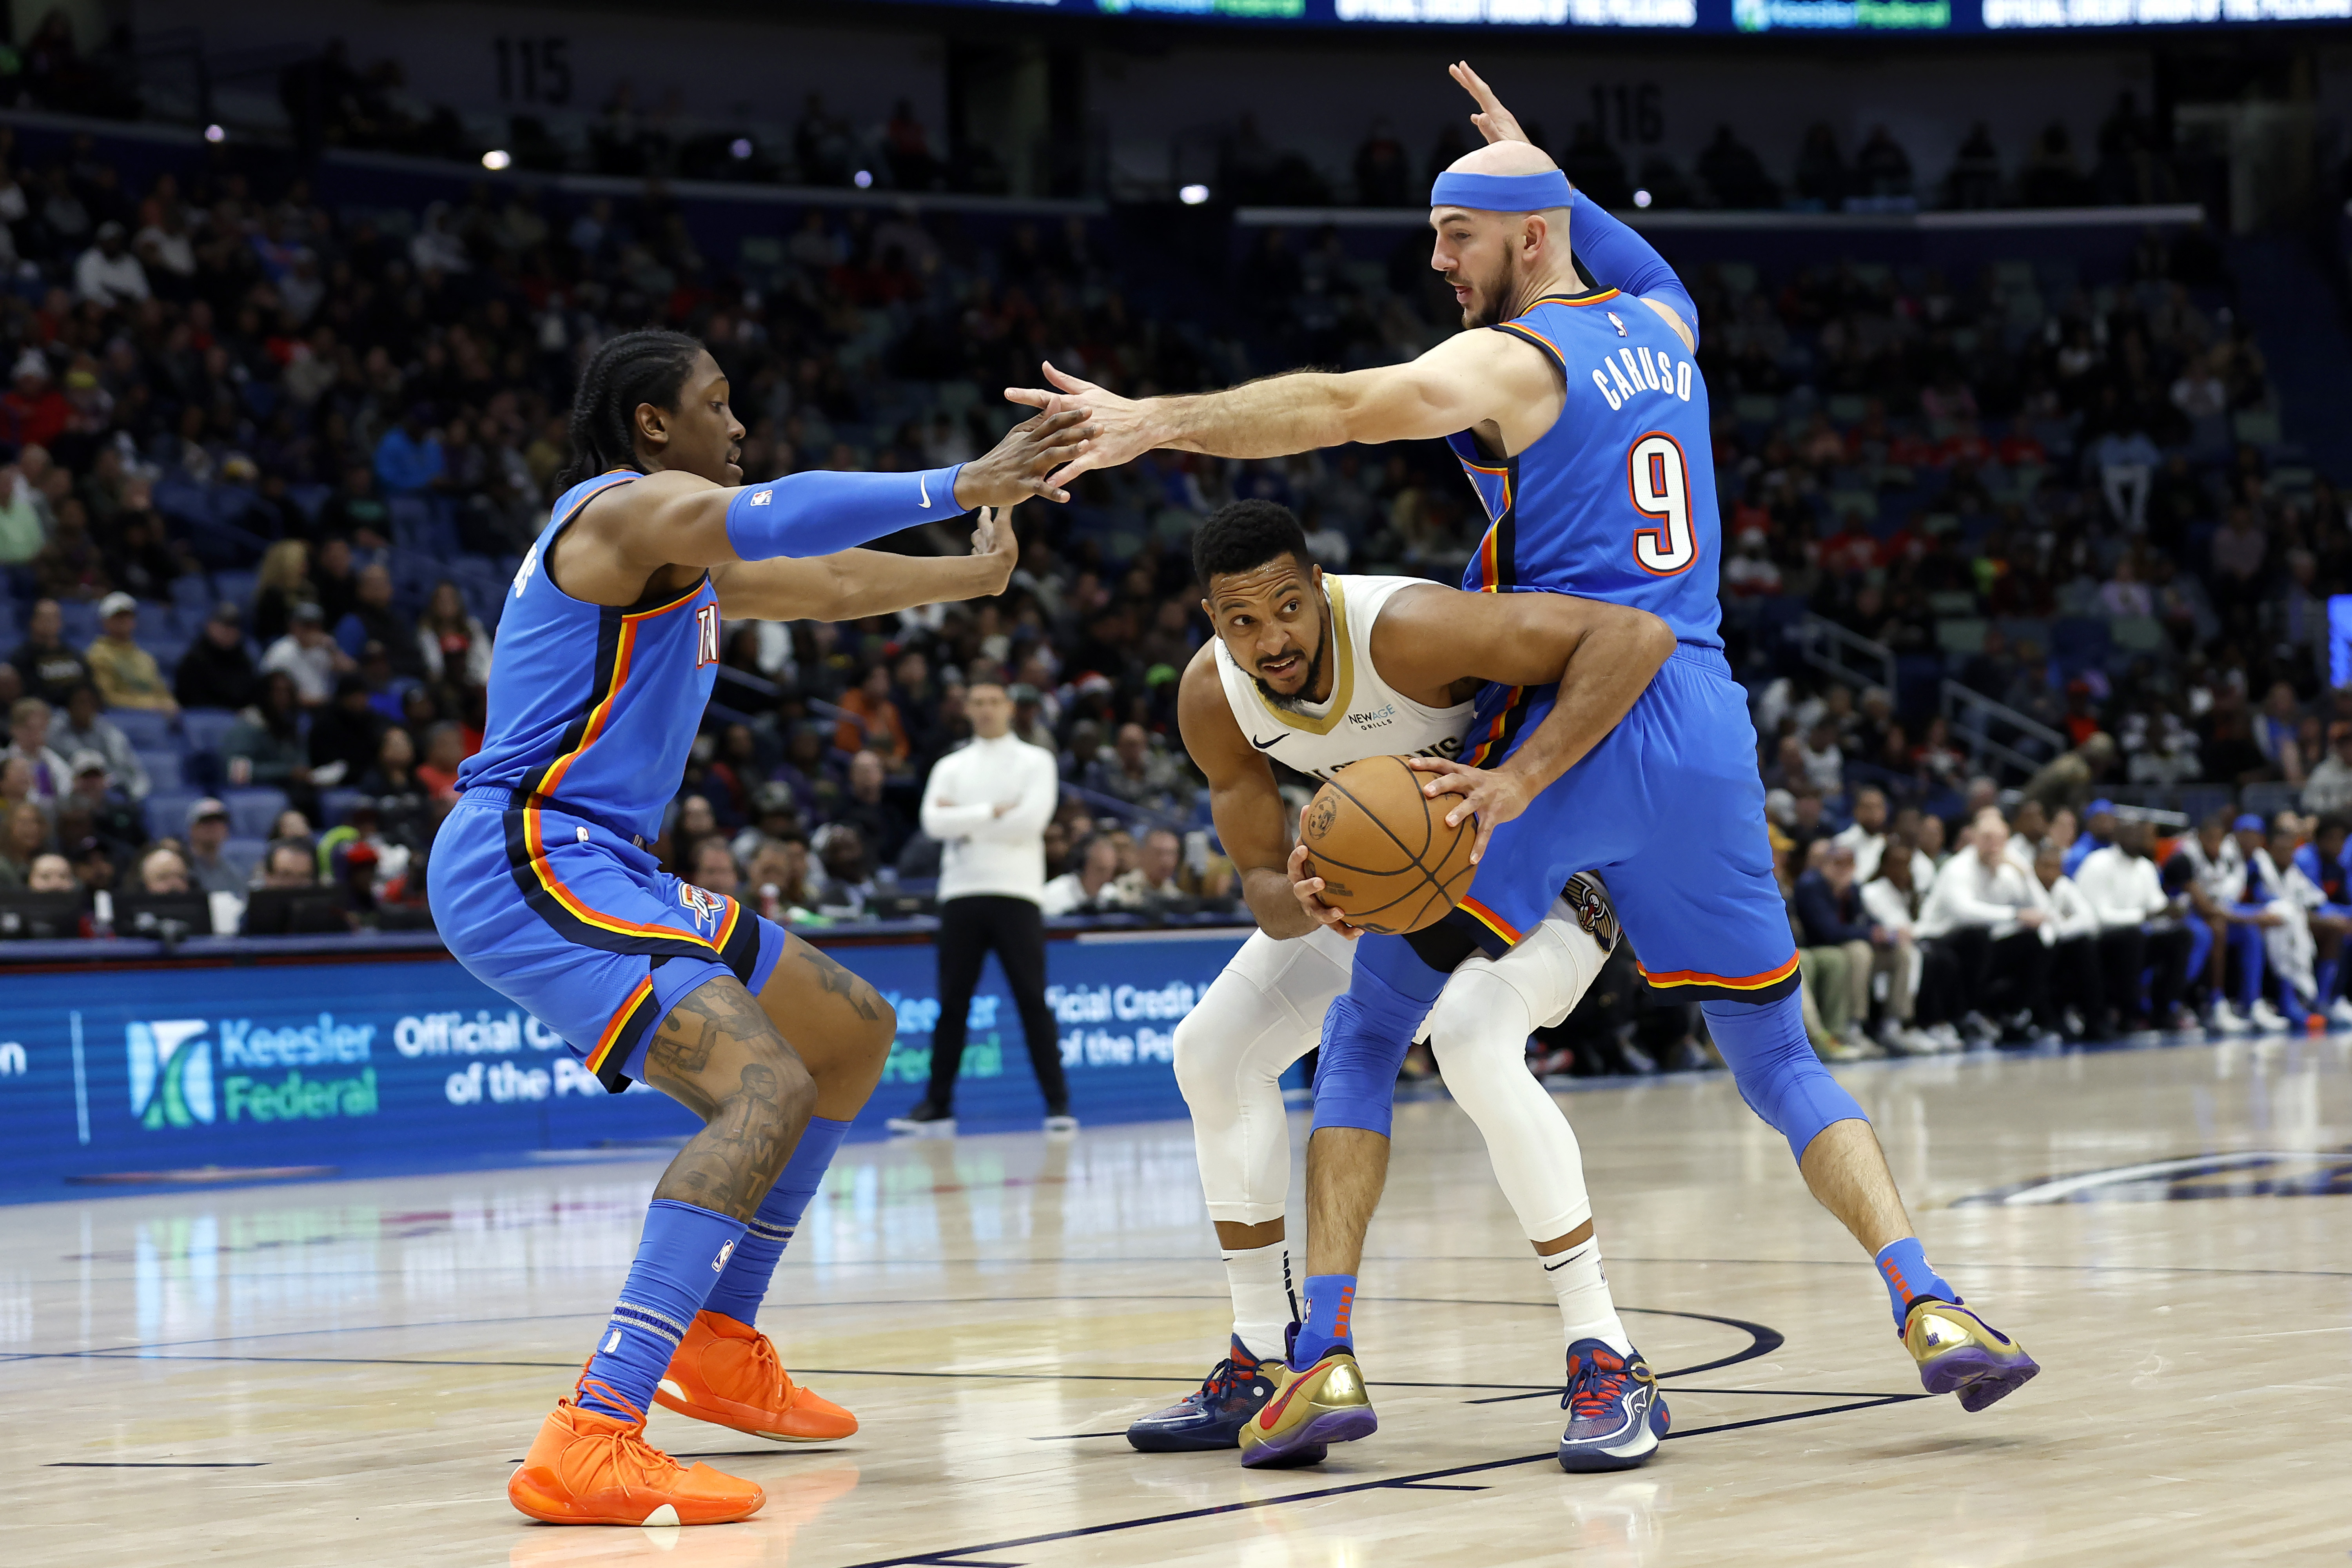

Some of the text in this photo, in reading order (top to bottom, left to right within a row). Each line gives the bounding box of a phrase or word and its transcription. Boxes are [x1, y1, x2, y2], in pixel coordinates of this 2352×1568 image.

[493, 37, 572, 105] 115
[1591, 81, 1663, 144] 116
[1592, 347, 1691, 411] CARUSO
[1628, 430, 1699, 577] 9
[1361, 719, 1392, 730] GRILLS
[220, 1012, 376, 1068] Keesler
[394, 1010, 522, 1057] Official
[1085, 1026, 1136, 1067] the
[225, 1067, 378, 1123] Federal
[445, 1061, 485, 1105] of
[487, 1060, 552, 1103] the
